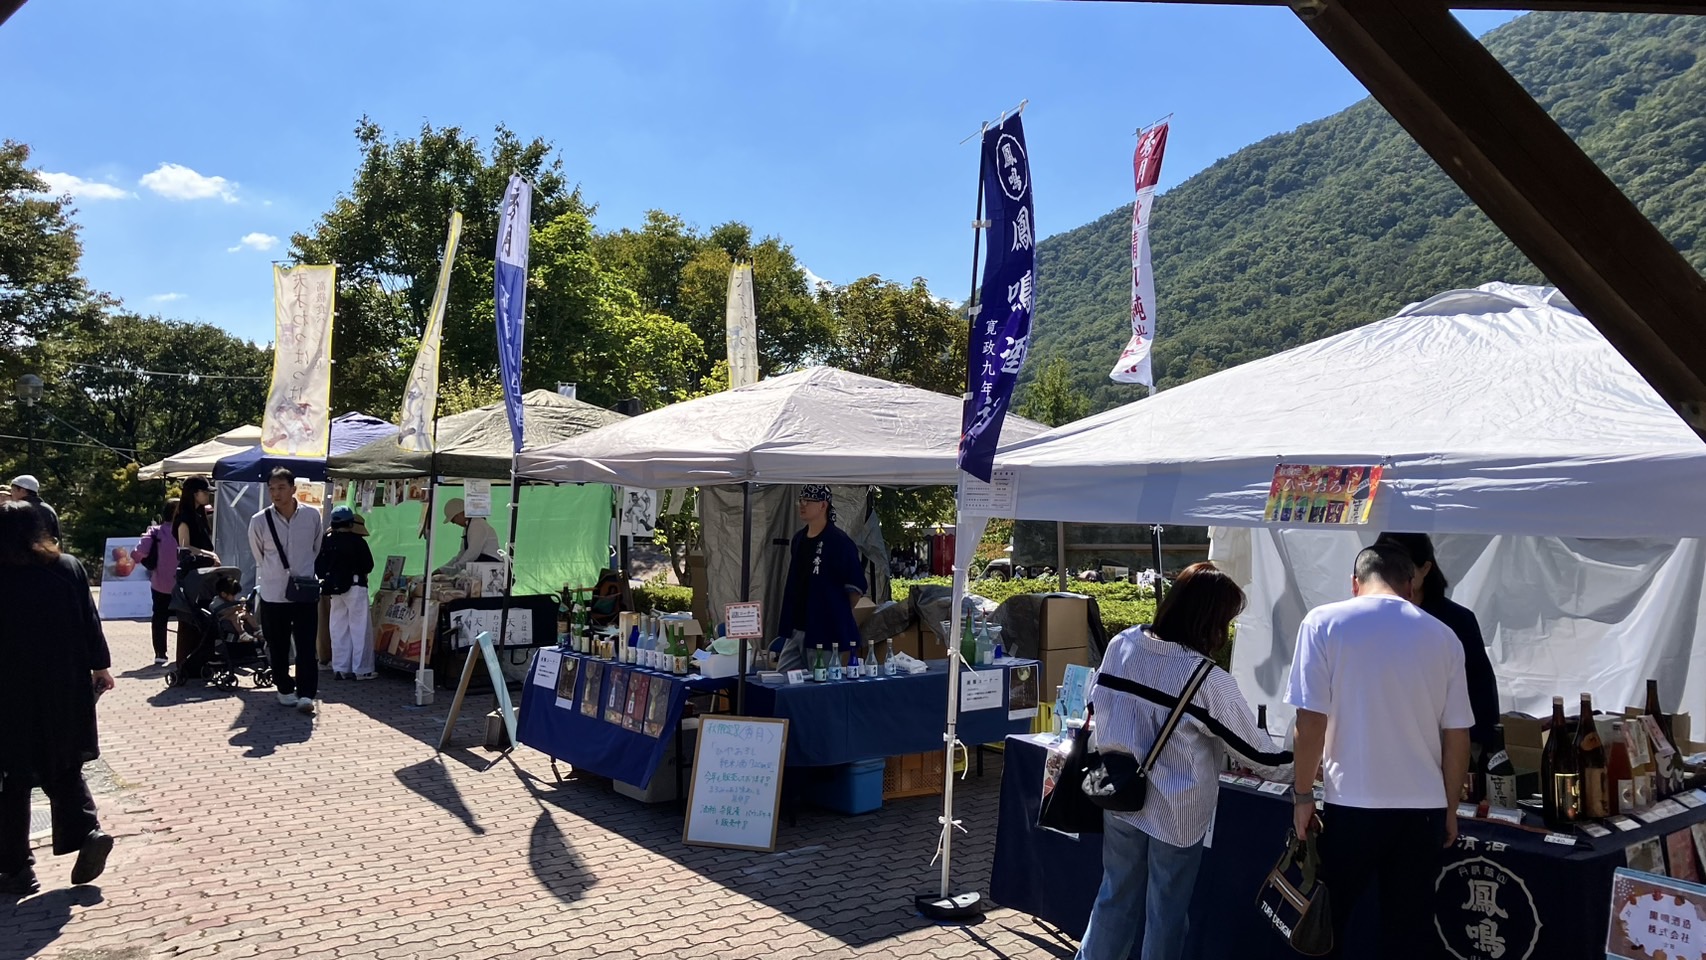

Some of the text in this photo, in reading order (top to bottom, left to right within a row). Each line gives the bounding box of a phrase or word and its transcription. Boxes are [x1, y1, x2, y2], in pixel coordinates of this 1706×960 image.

[1001, 142, 1023, 192] 鳳鳴
[981, 319, 999, 397] 寛政九年
[1283, 477, 1358, 494] ひやおろし
[506, 618, 516, 641] 天才
[1457, 835, 1511, 851] 清酒
[1461, 878, 1510, 960] 鳳鳴
[1648, 925, 1691, 944] 株式会社
